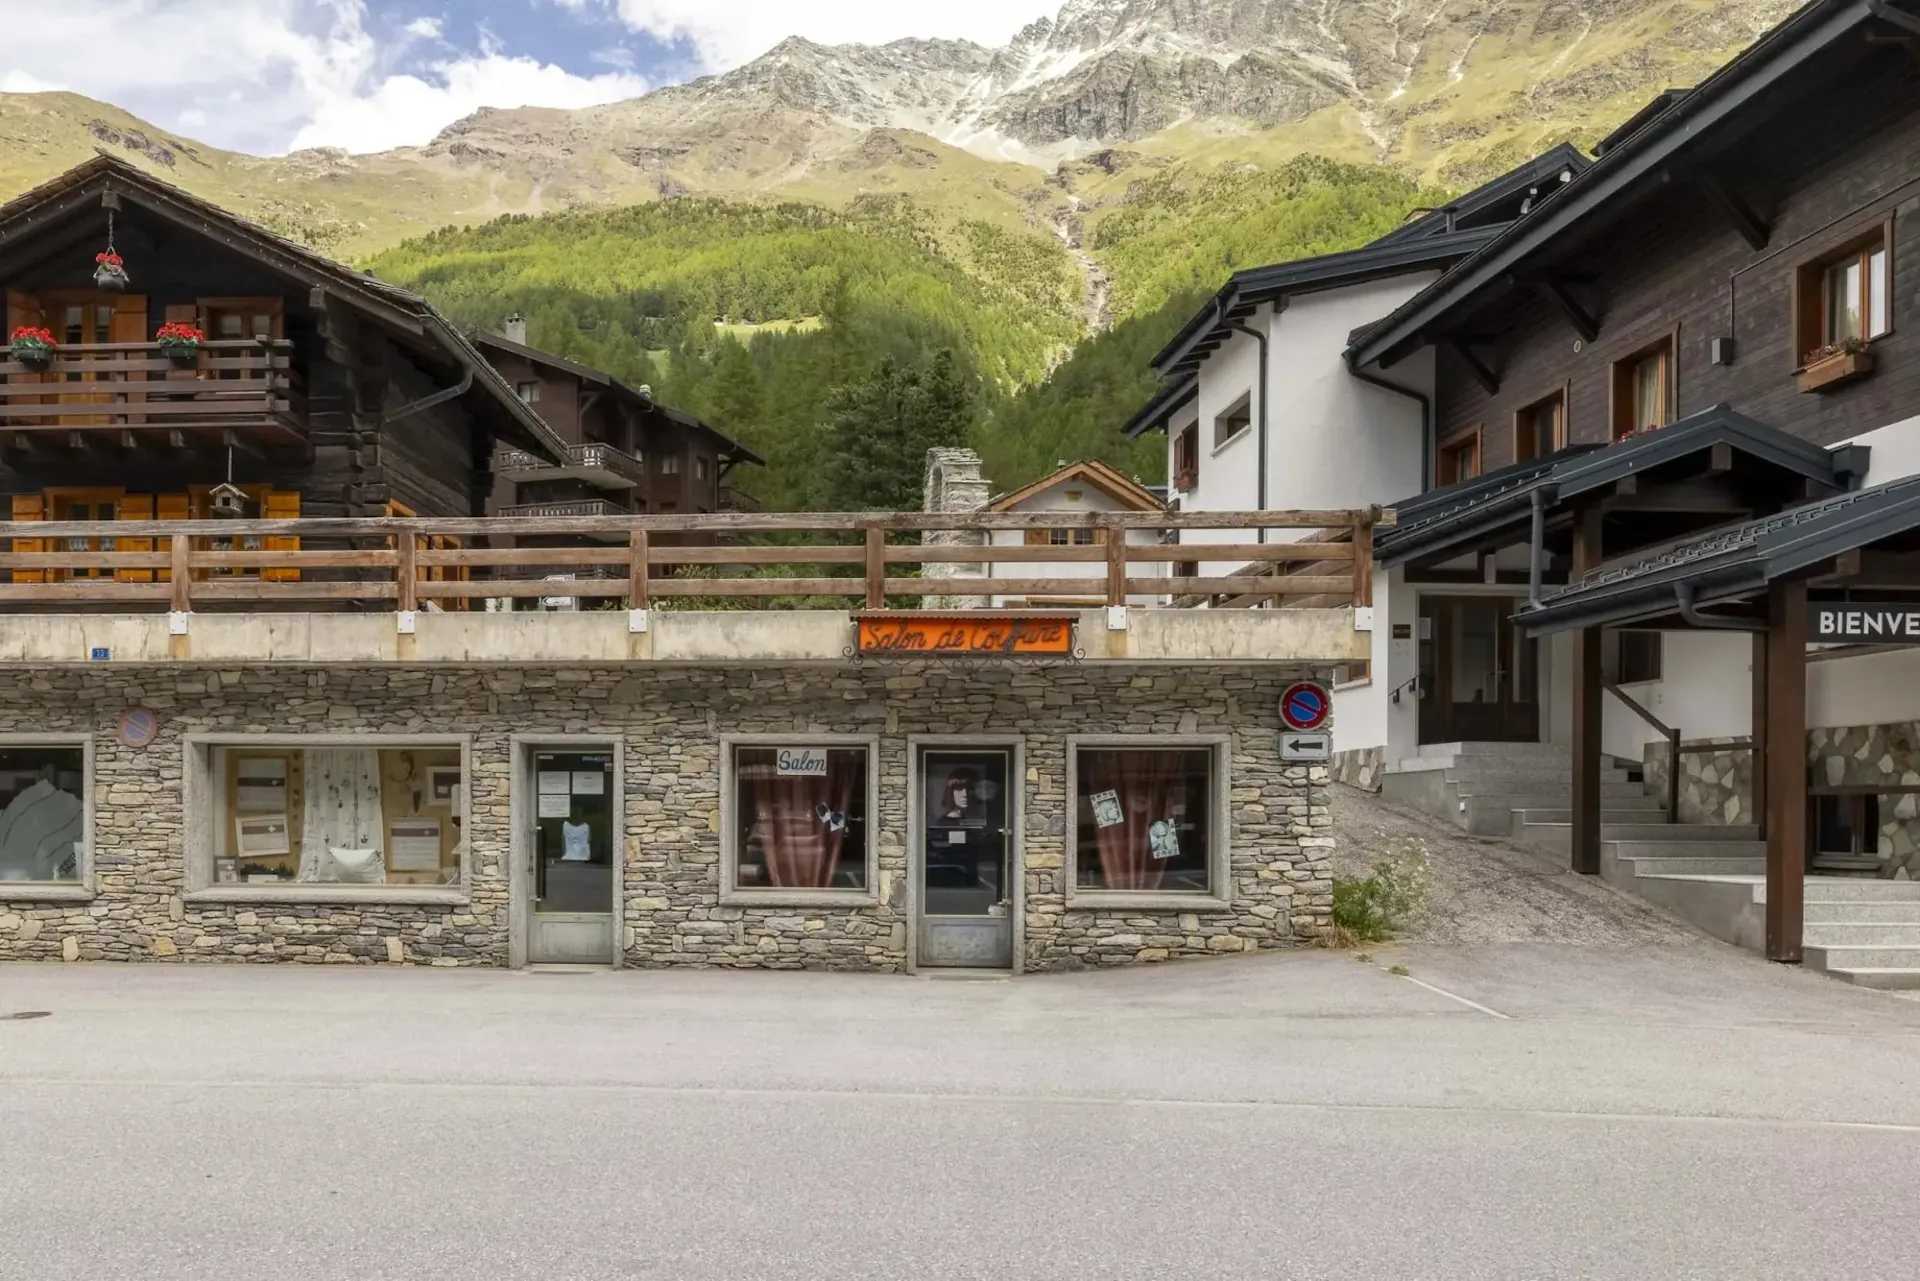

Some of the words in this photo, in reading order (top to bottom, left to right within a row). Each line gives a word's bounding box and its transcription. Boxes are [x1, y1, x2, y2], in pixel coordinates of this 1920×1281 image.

[865, 622, 927, 650] Salon
[933, 620, 965, 650] de
[1820, 611, 1920, 635] BIENVE
[779, 750, 826, 771] Salon
